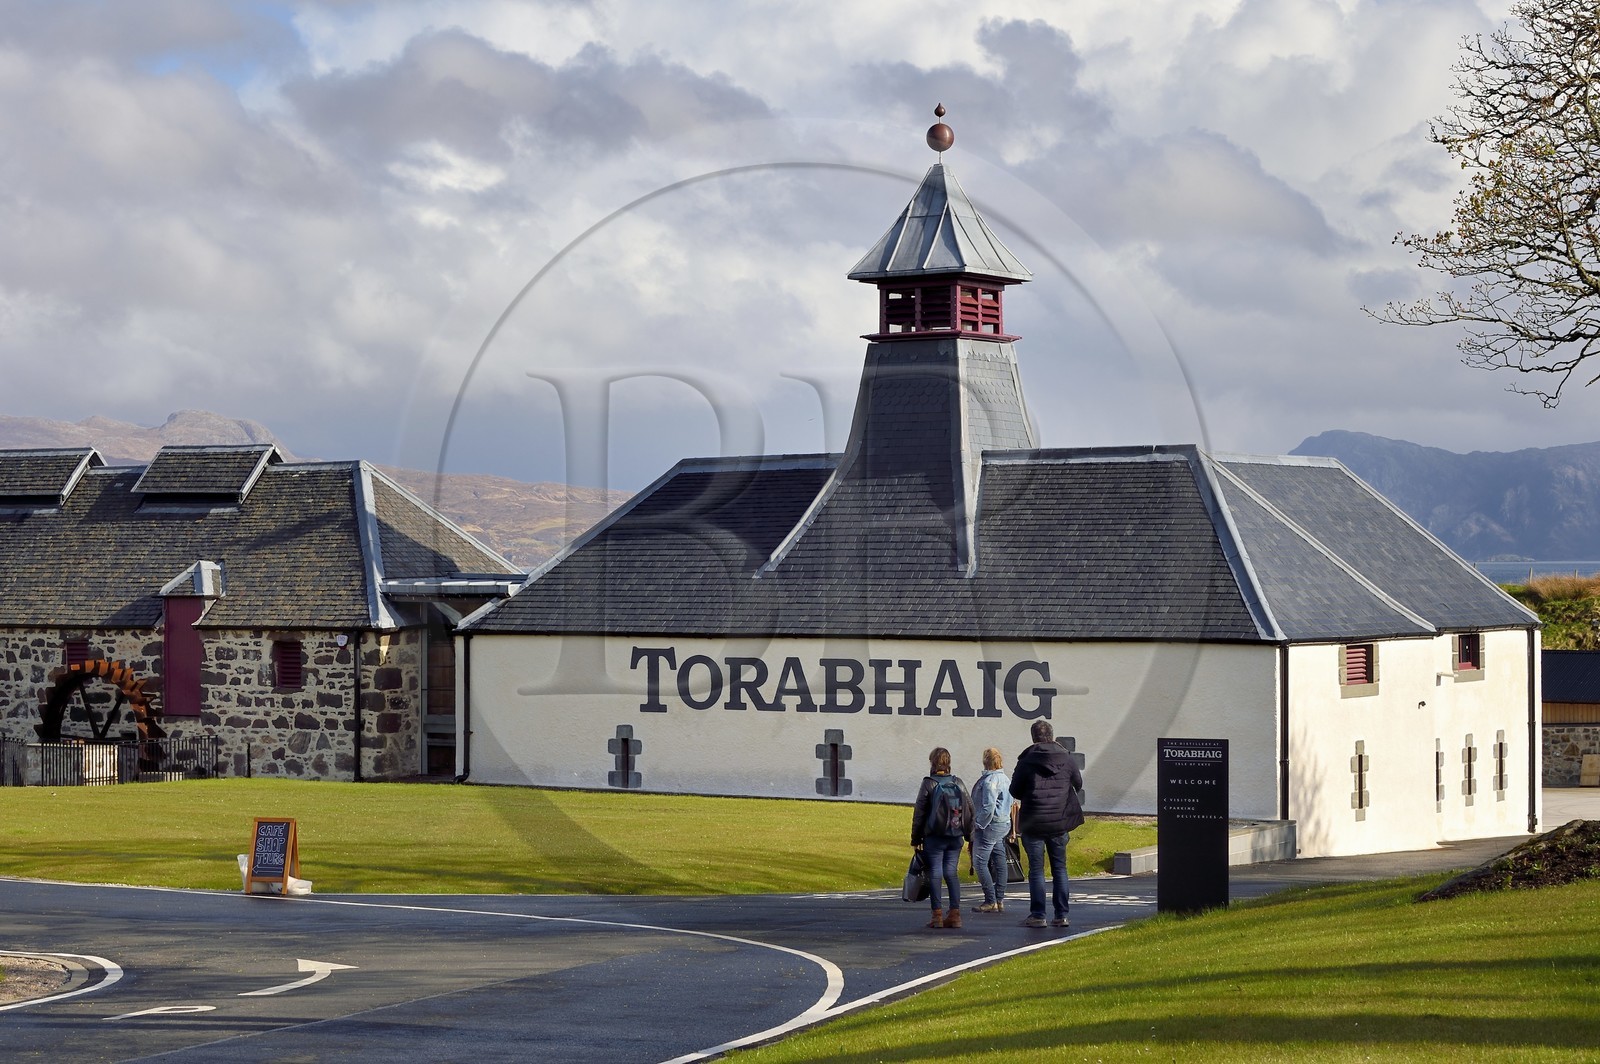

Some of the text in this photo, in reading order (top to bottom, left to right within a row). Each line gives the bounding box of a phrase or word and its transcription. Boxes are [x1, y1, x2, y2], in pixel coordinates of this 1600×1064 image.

[630, 646, 1057, 720] TORABHAIG
[1164, 749, 1222, 758] TORABHAIG
[259, 823, 286, 836] CAFÉ
[256, 838, 285, 852] SHOP
[256, 853, 284, 865] TOURS
